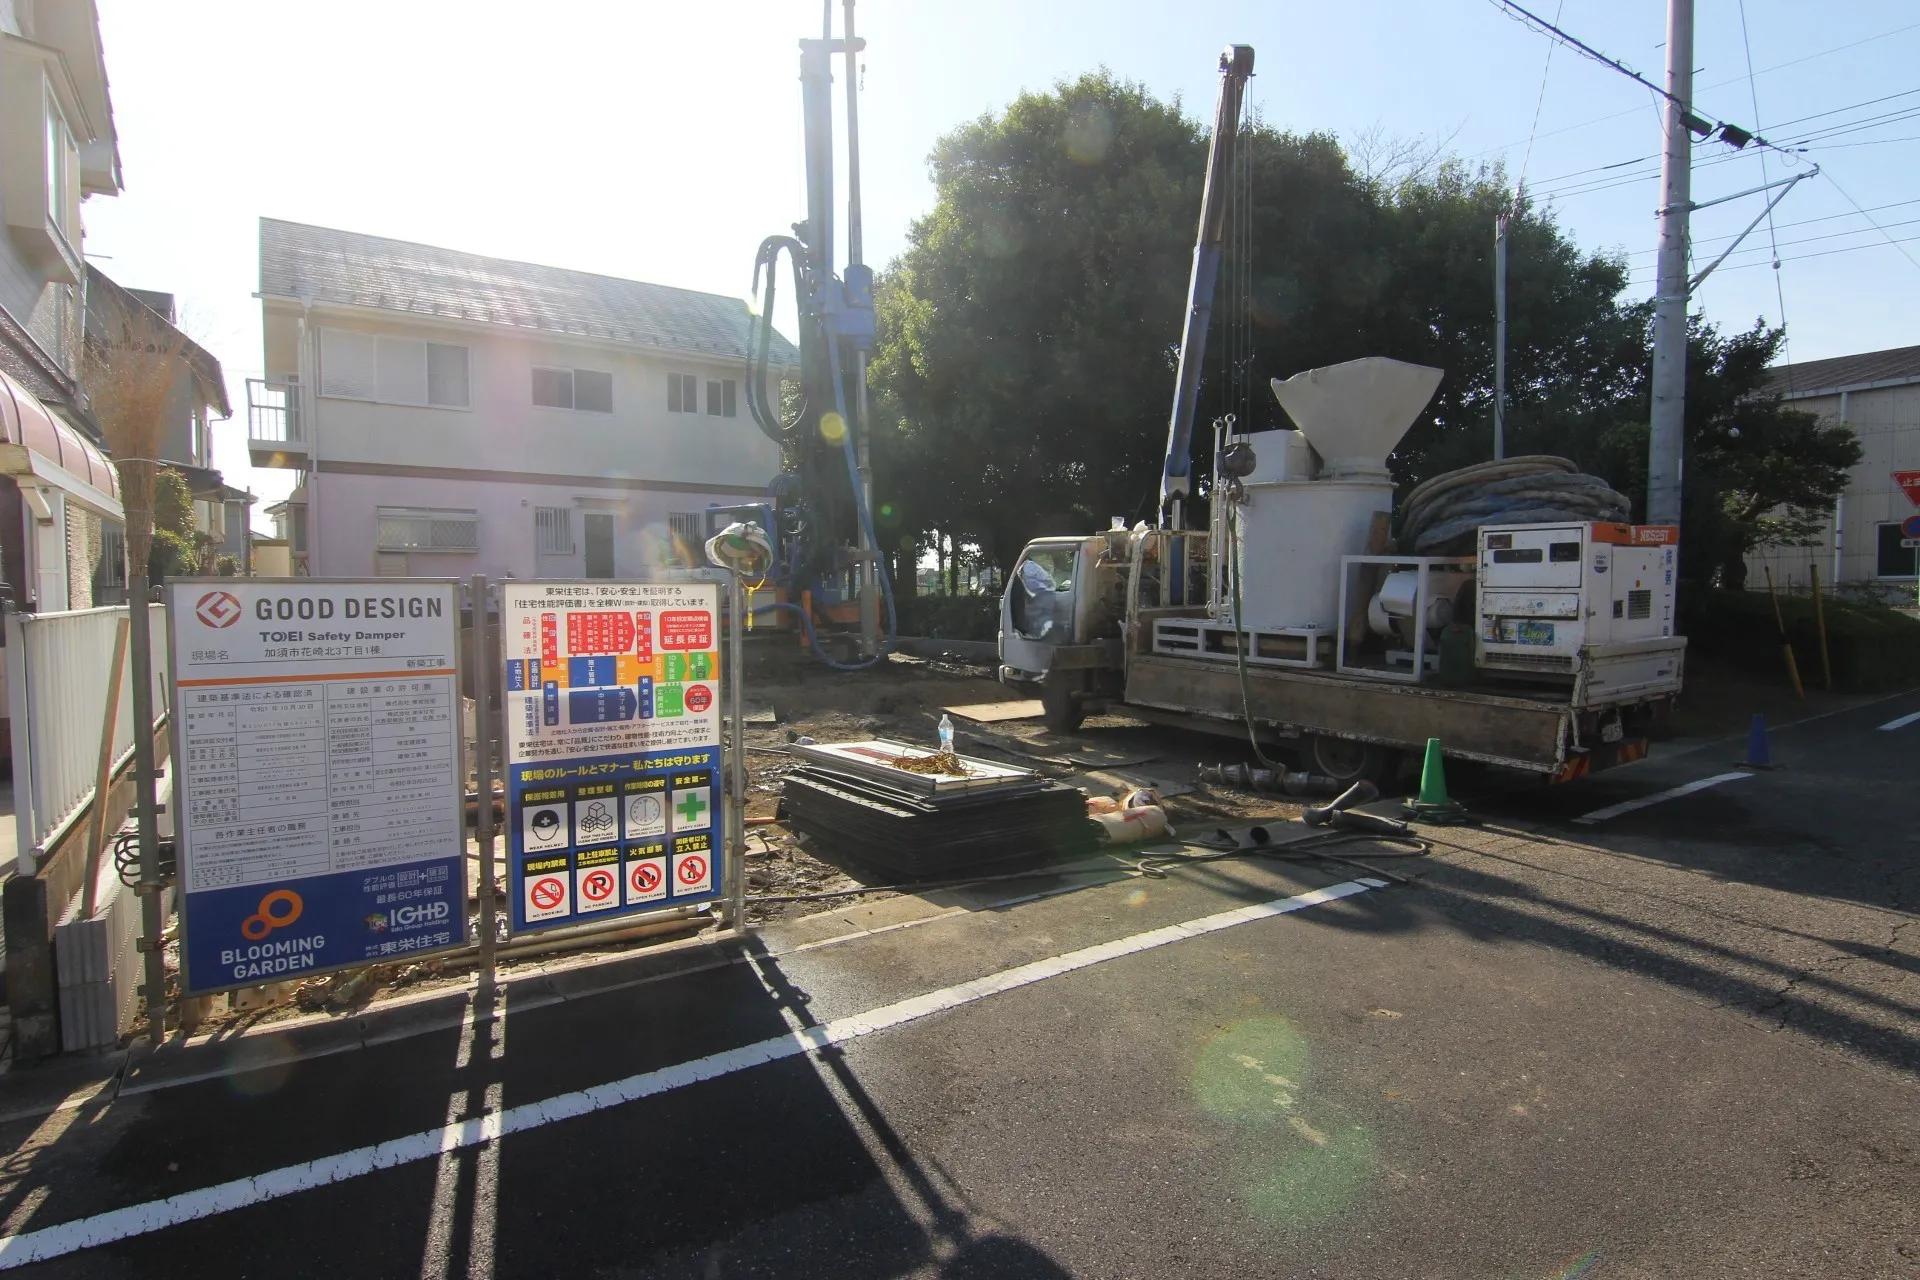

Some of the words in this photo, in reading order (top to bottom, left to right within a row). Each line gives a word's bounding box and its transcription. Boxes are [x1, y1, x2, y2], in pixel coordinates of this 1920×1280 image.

[256, 598, 334, 620] GOOD
[345, 597, 442, 618] DESIGN
[308, 631, 351, 642] Safety
[355, 631, 405, 641] Damper
[664, 635, 708, 645] 延長保証
[191, 650, 229, 661] 現場名
[264, 645, 381, 658] 加須市花崎北3丁目1棟
[406, 658, 445, 668] 新築工事
[197, 689, 313, 703] 建築基準法による確認済
[521, 763, 630, 781] 現場のルールとマナー
[633, 753, 711, 771] 私たちは守ります
[675, 775, 707, 785] 安全第一
[675, 835, 707, 845] 関係者以外
[629, 845, 663, 856] 火気厳禁
[676, 842, 708, 852] 立入禁止
[364, 874, 395, 885] ダブルの
[390, 902, 449, 926] IGHD
[380, 932, 450, 955] 東栄住宅
[221, 934, 325, 966] BLOOMING
[234, 953, 315, 979] GARDEN
